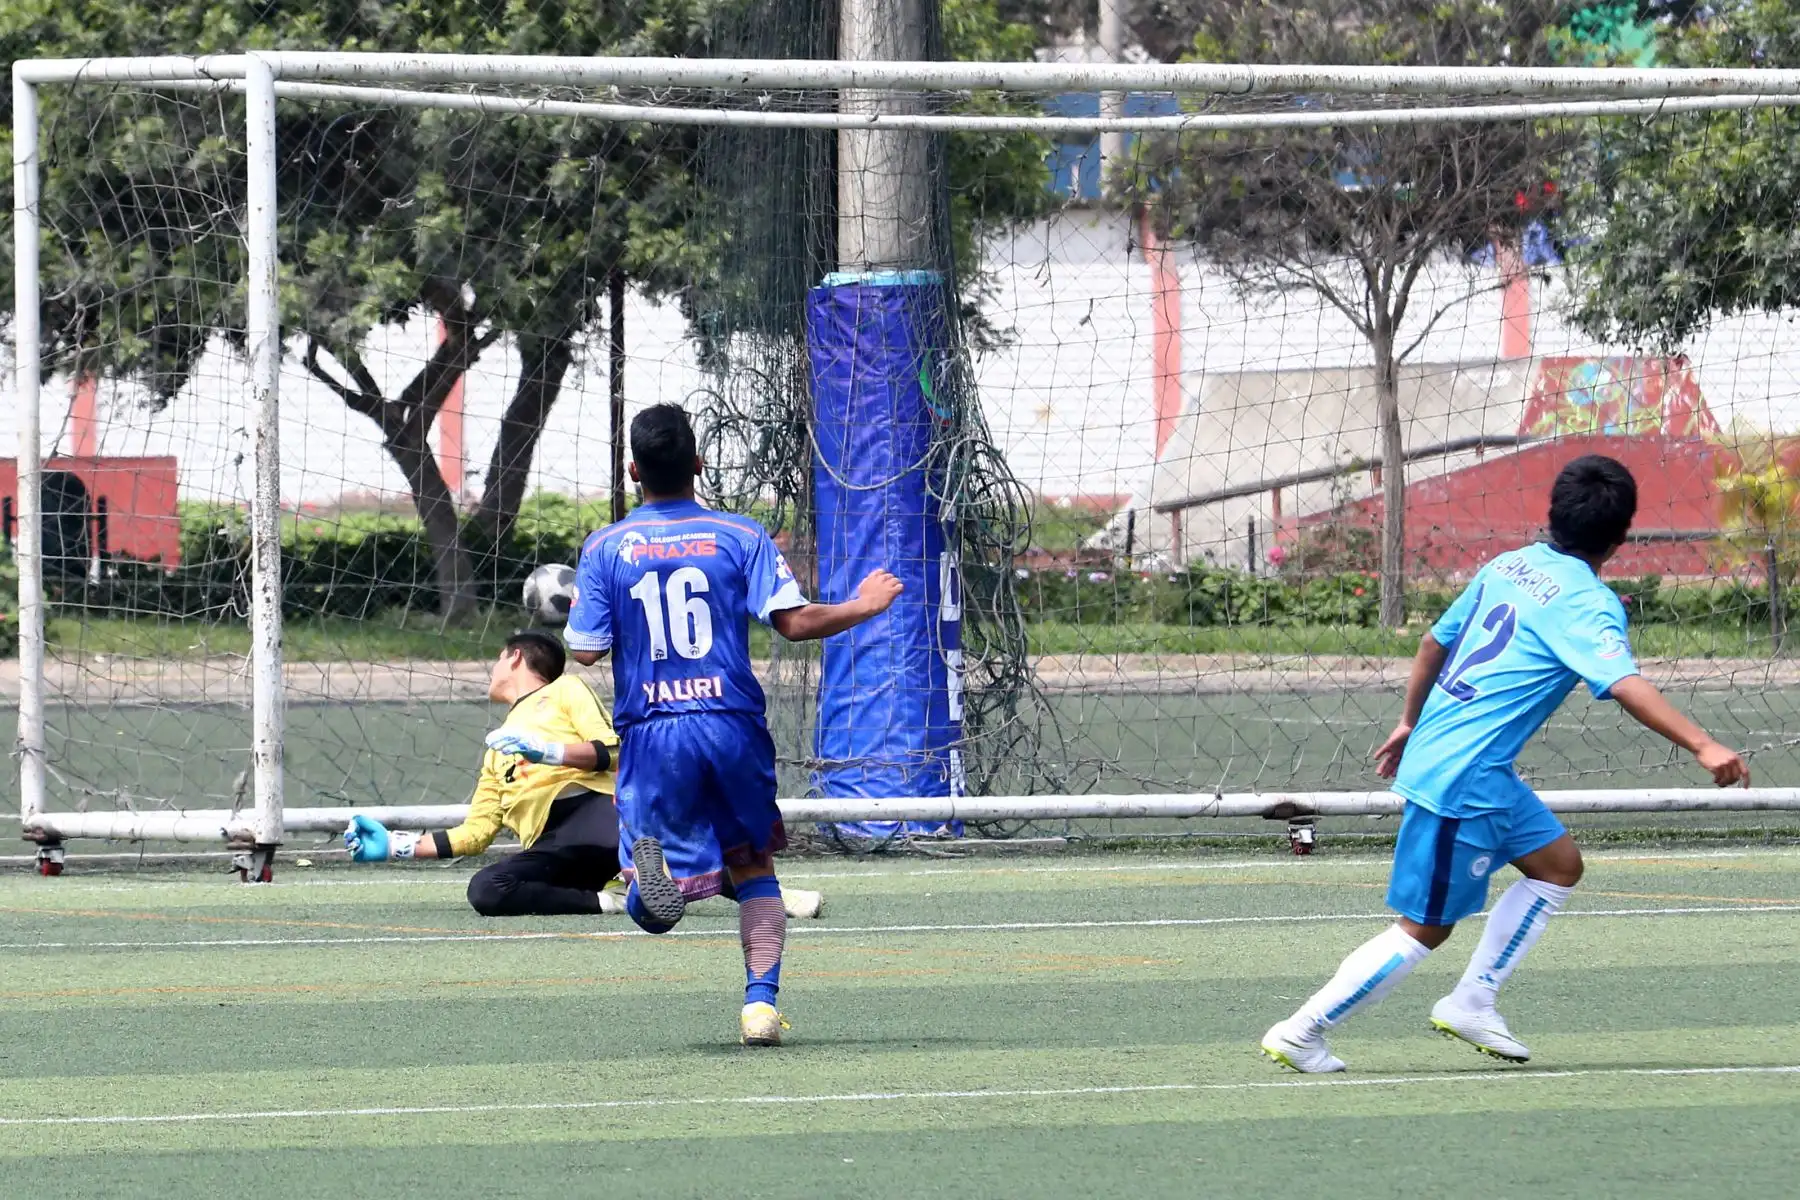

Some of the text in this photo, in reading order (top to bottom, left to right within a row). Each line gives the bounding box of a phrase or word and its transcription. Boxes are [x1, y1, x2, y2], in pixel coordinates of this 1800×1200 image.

[632, 540, 717, 561] PRAXIS
[630, 567, 713, 661] 16
[1436, 583, 1517, 702] 12
[642, 676, 723, 703] YAURI
